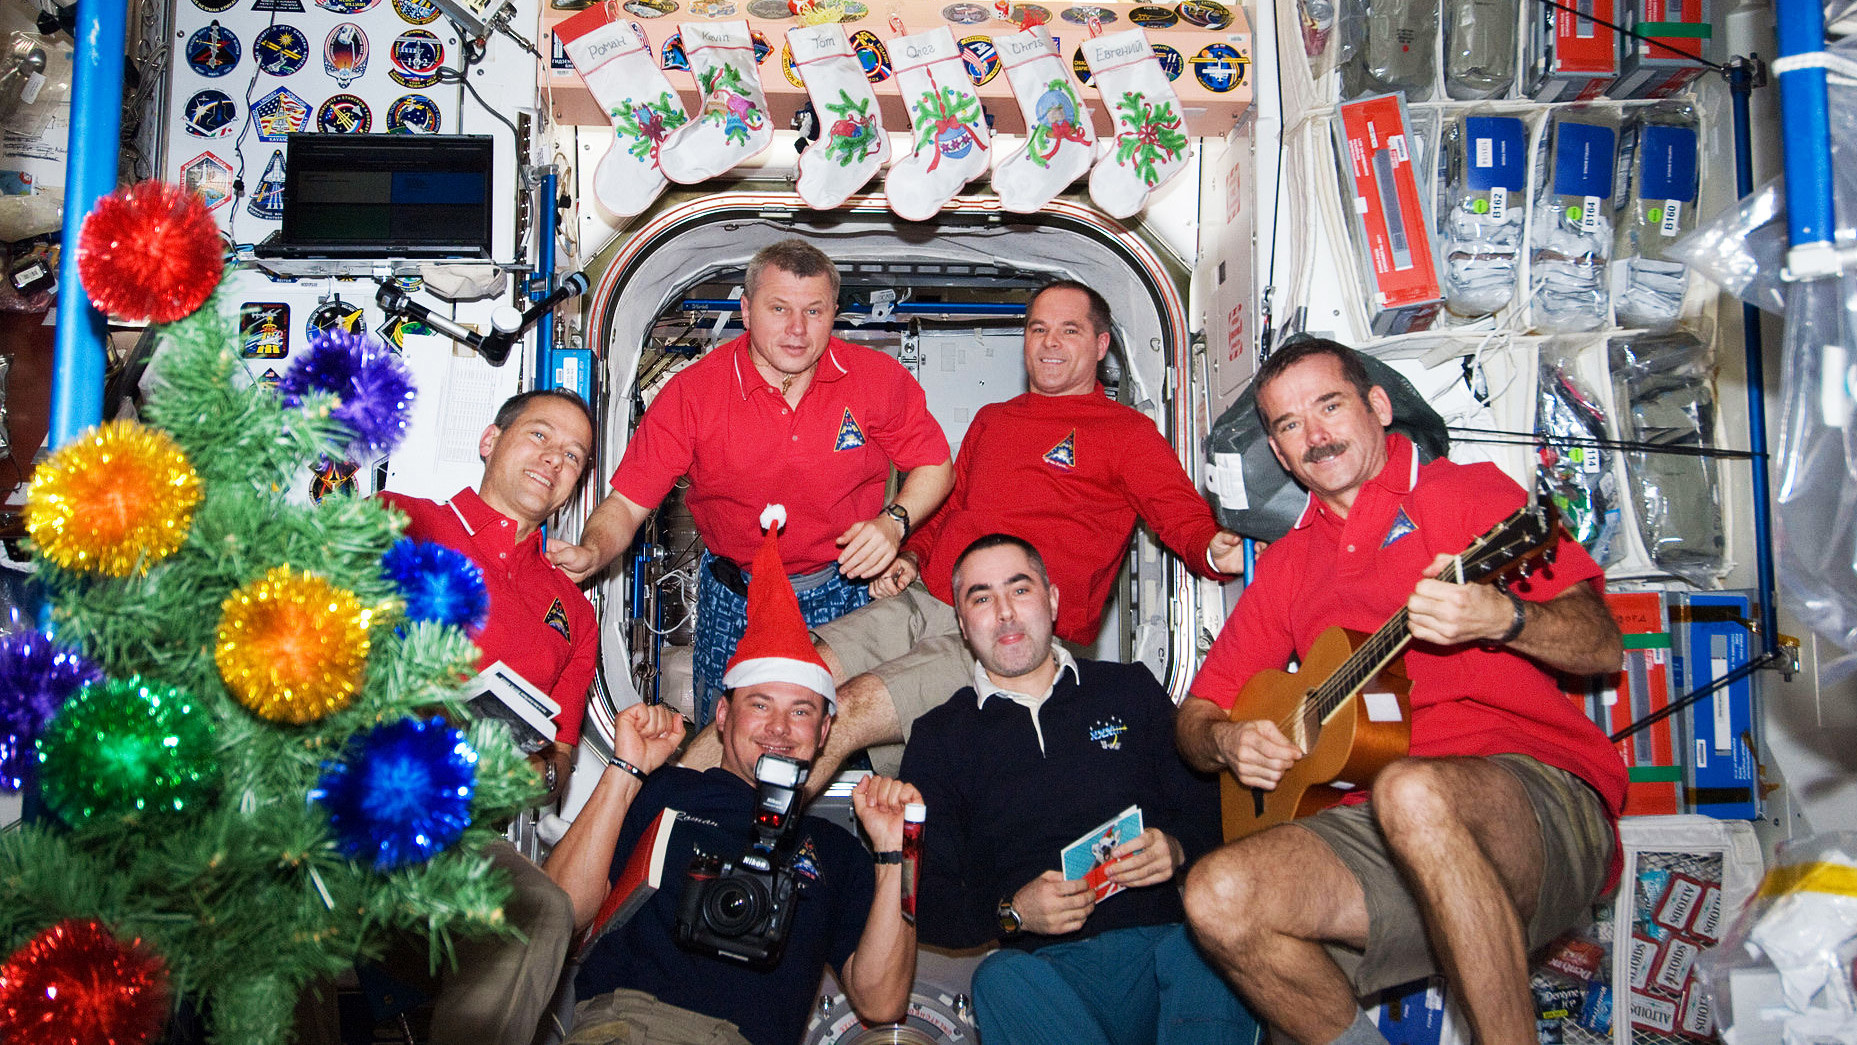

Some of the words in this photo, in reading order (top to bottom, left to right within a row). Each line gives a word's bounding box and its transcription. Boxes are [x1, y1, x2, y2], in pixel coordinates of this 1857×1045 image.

[587, 36, 627, 60] Роман
[702, 31, 731, 42] Kevin
[811, 34, 835, 49] Tom
[1011, 39, 1045, 55] Chris
[1095, 40, 1144, 62] Евгений
[1492, 193, 1503, 219] B162
[1585, 202, 1596, 227] B164
[1664, 205, 1677, 231] B160
[676, 810, 719, 827] Roman
[742, 856, 767, 868] Nikon
[1669, 884, 1695, 924] ALTOIDS
[1664, 945, 1688, 986] ALTOIDS
